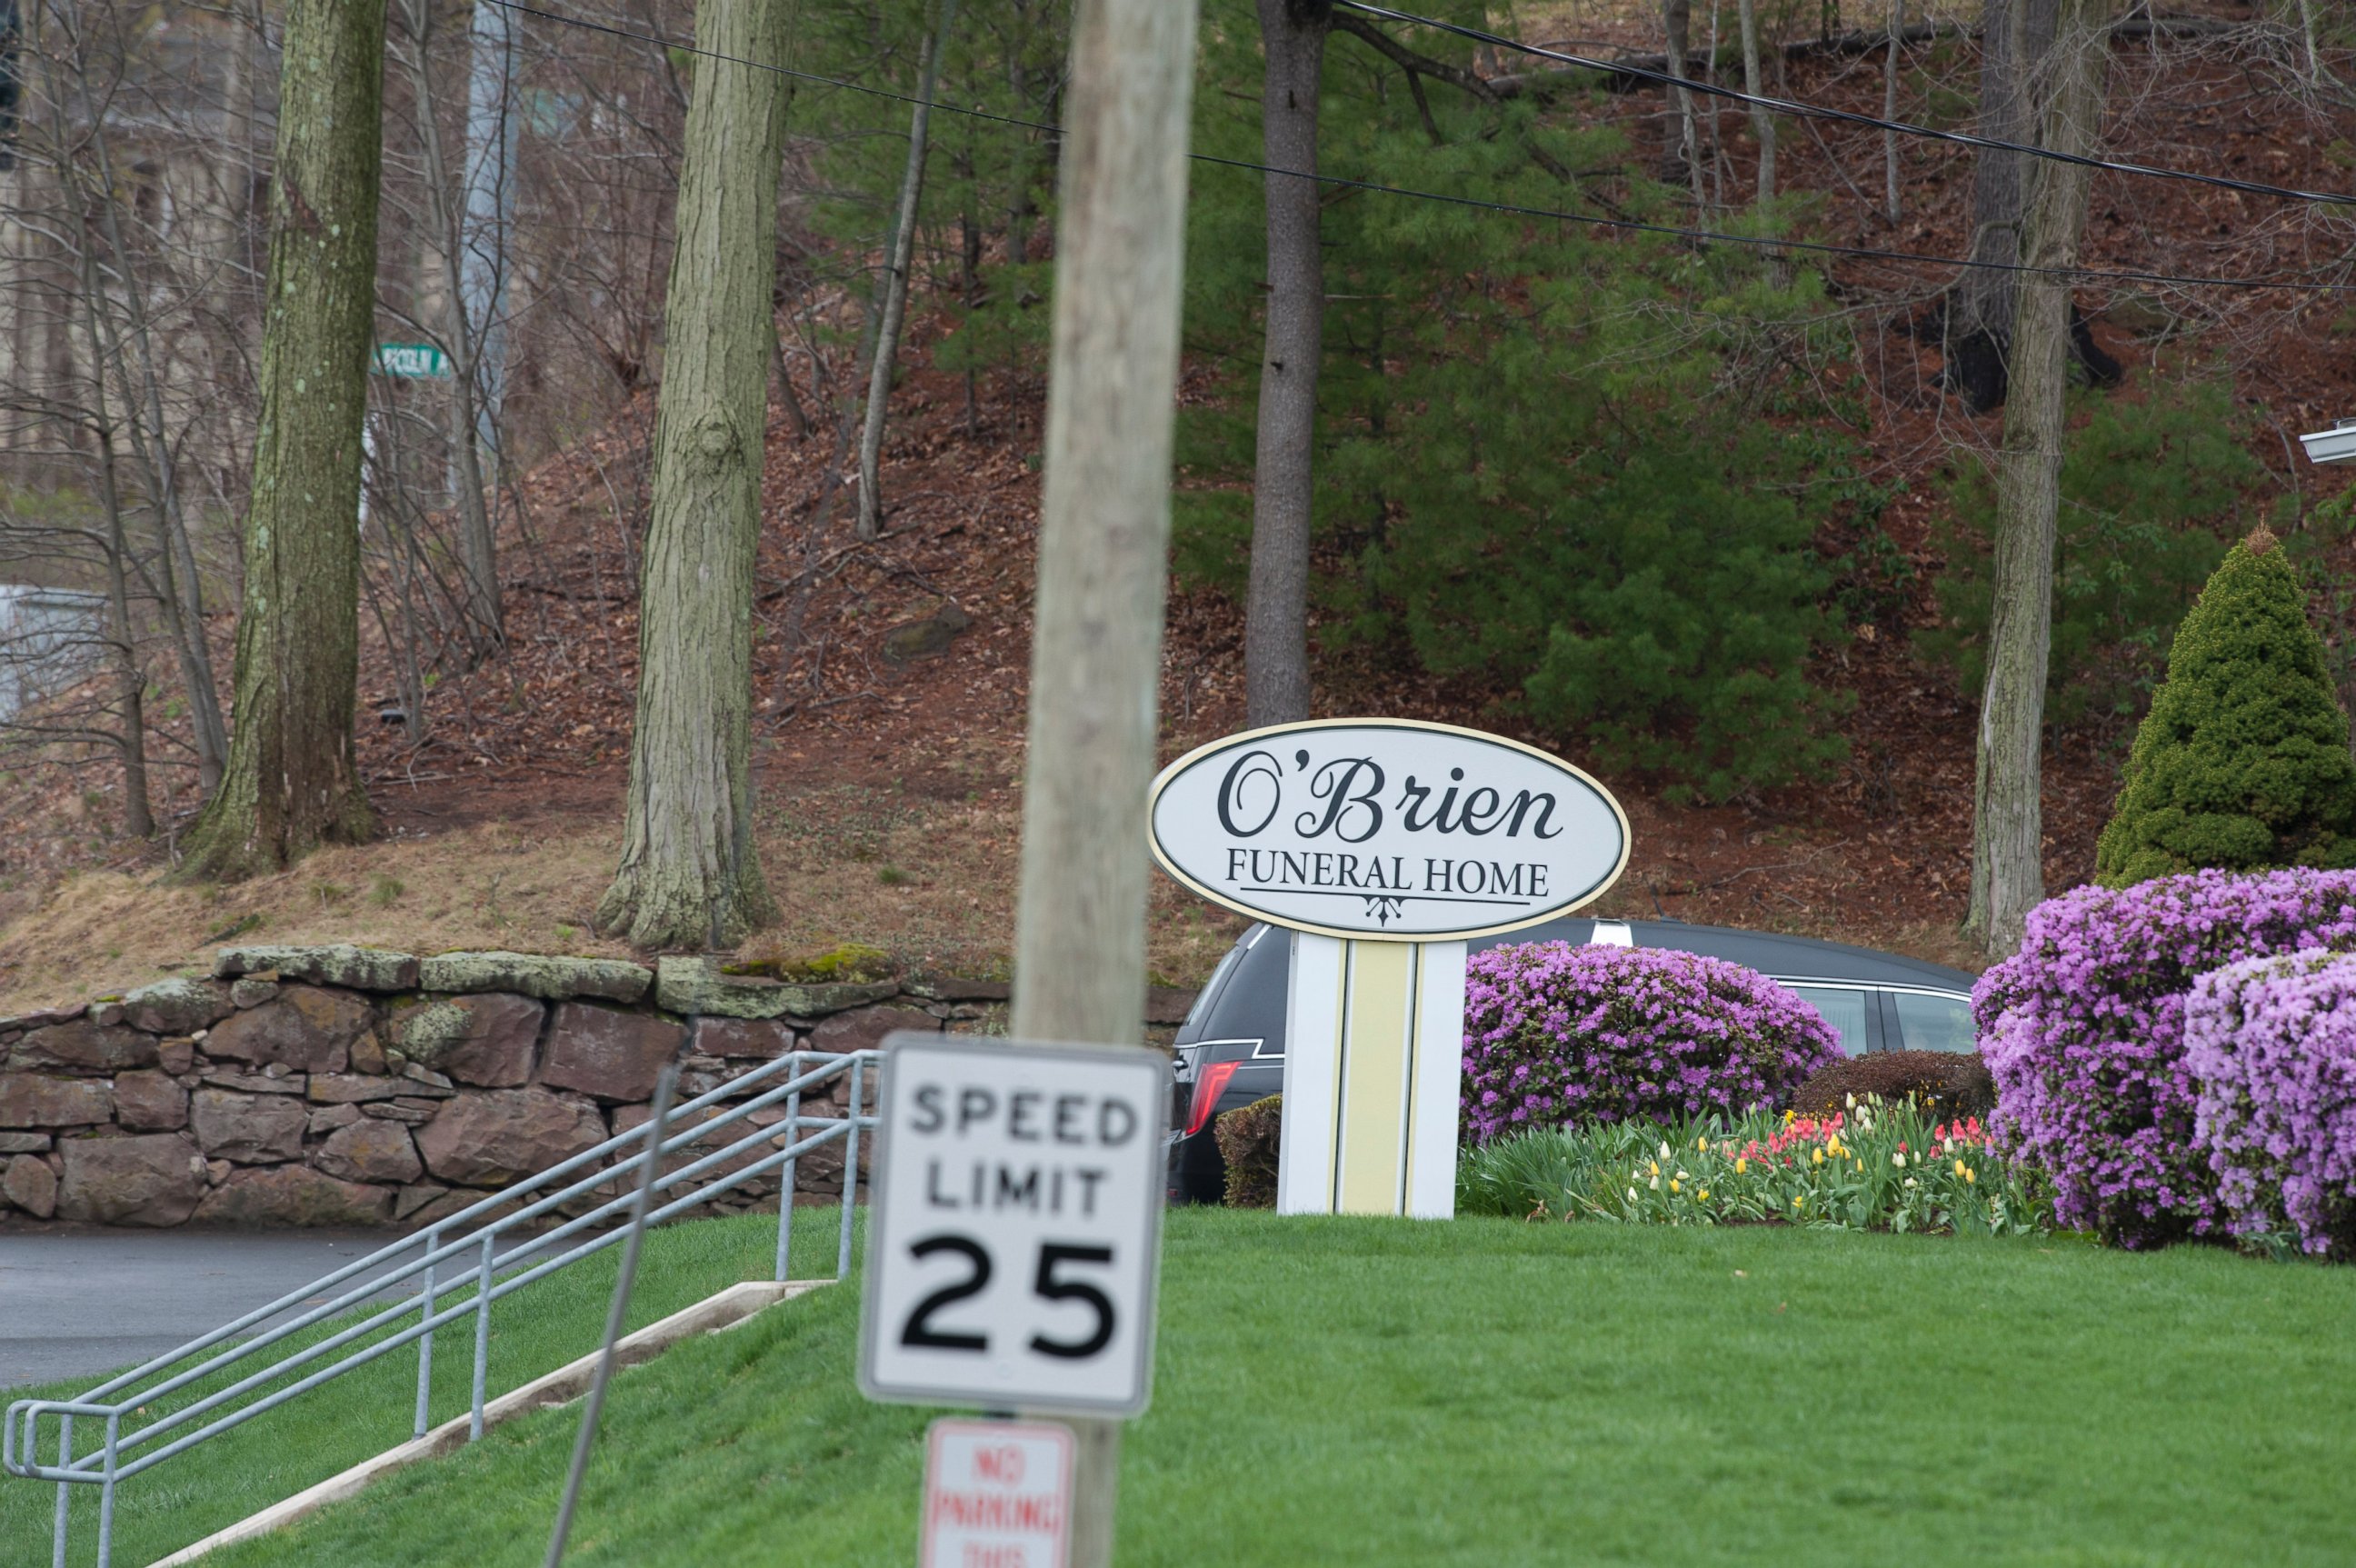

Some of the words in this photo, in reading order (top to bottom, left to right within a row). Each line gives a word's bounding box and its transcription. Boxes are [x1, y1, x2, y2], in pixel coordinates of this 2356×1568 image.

[1217, 749, 1563, 843] O'Brien
[1224, 848, 1413, 890] FUNERAL
[1424, 858, 1549, 896] HOME
[910, 1084, 1139, 1146] SPEED
[924, 1157, 1107, 1216] LIMIT
[901, 1234, 1116, 1359] 25
[971, 1443, 1026, 1487] NO
